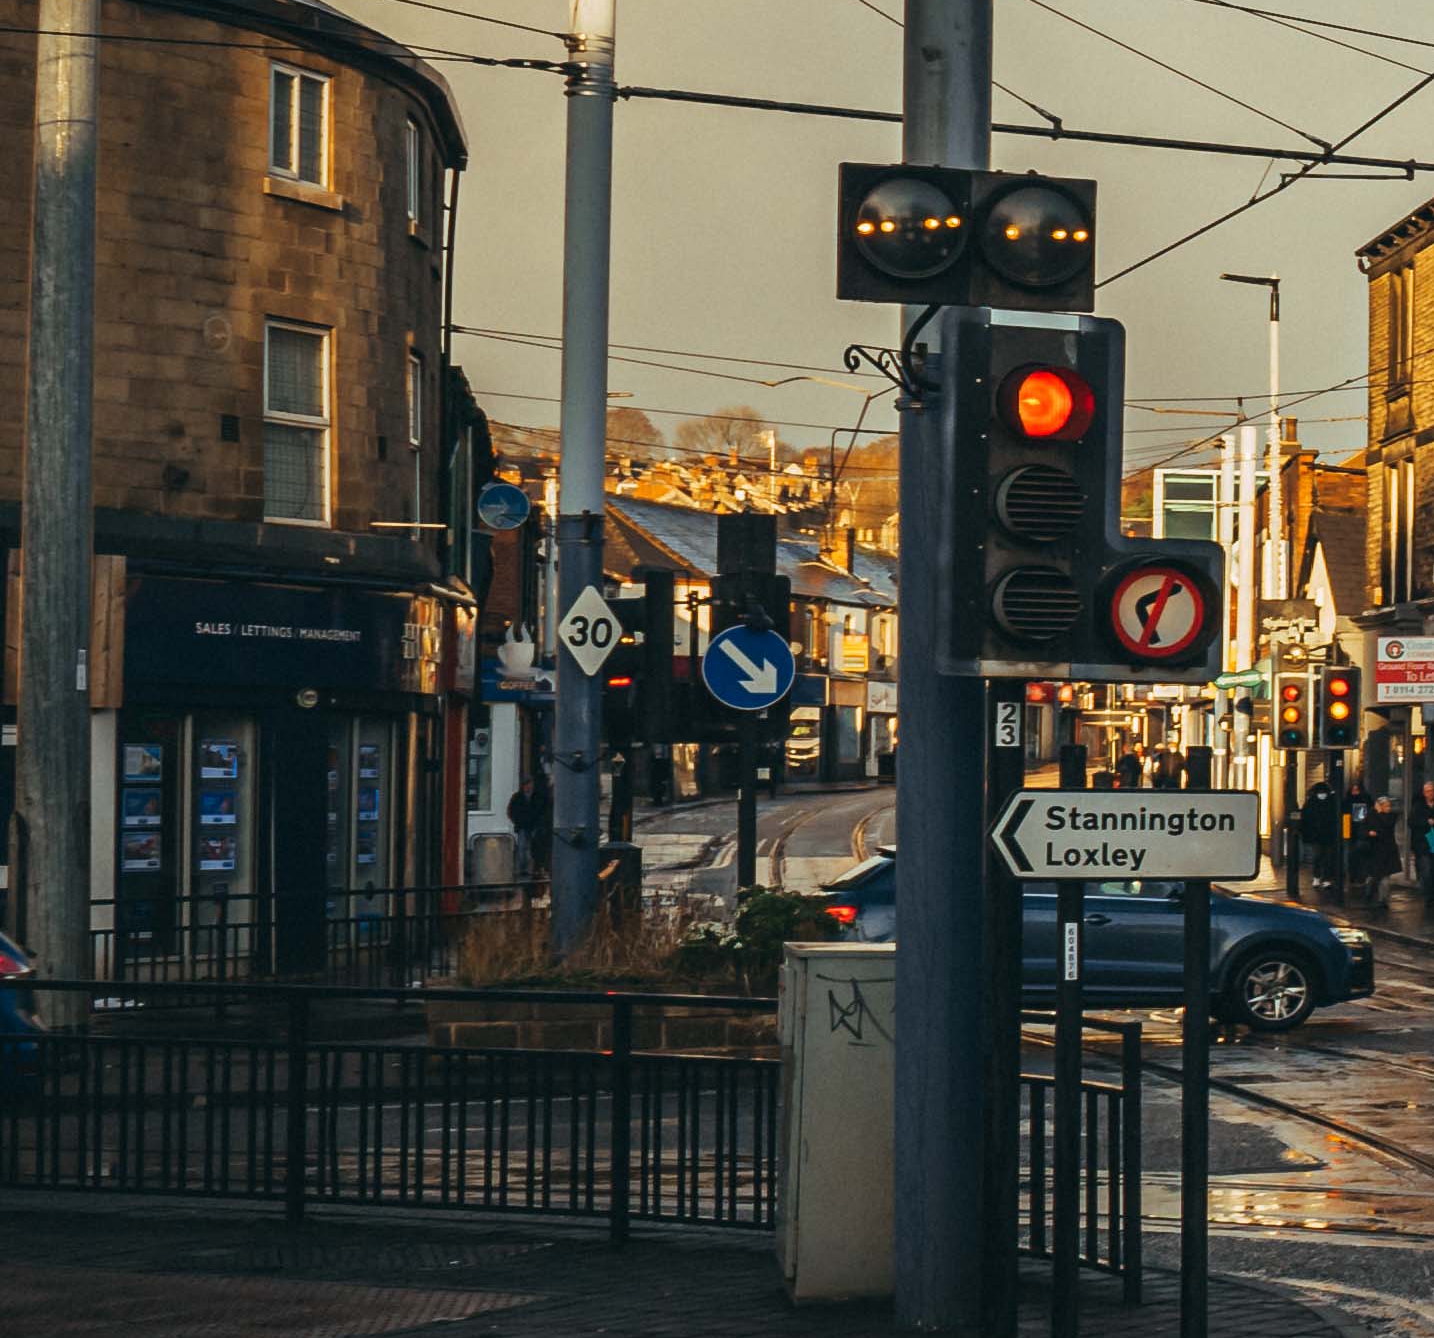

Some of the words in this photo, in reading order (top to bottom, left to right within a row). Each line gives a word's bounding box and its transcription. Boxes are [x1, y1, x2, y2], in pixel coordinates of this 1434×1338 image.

[195, 622, 232, 636] SALES
[241, 624, 293, 638] LETTINGS
[300, 628, 361, 642] MANAGEMENT
[568, 616, 613, 648] 30
[1405, 671, 1418, 681] To
[1046, 806, 1235, 836] Stannington
[1046, 842, 1147, 871] Loxley
